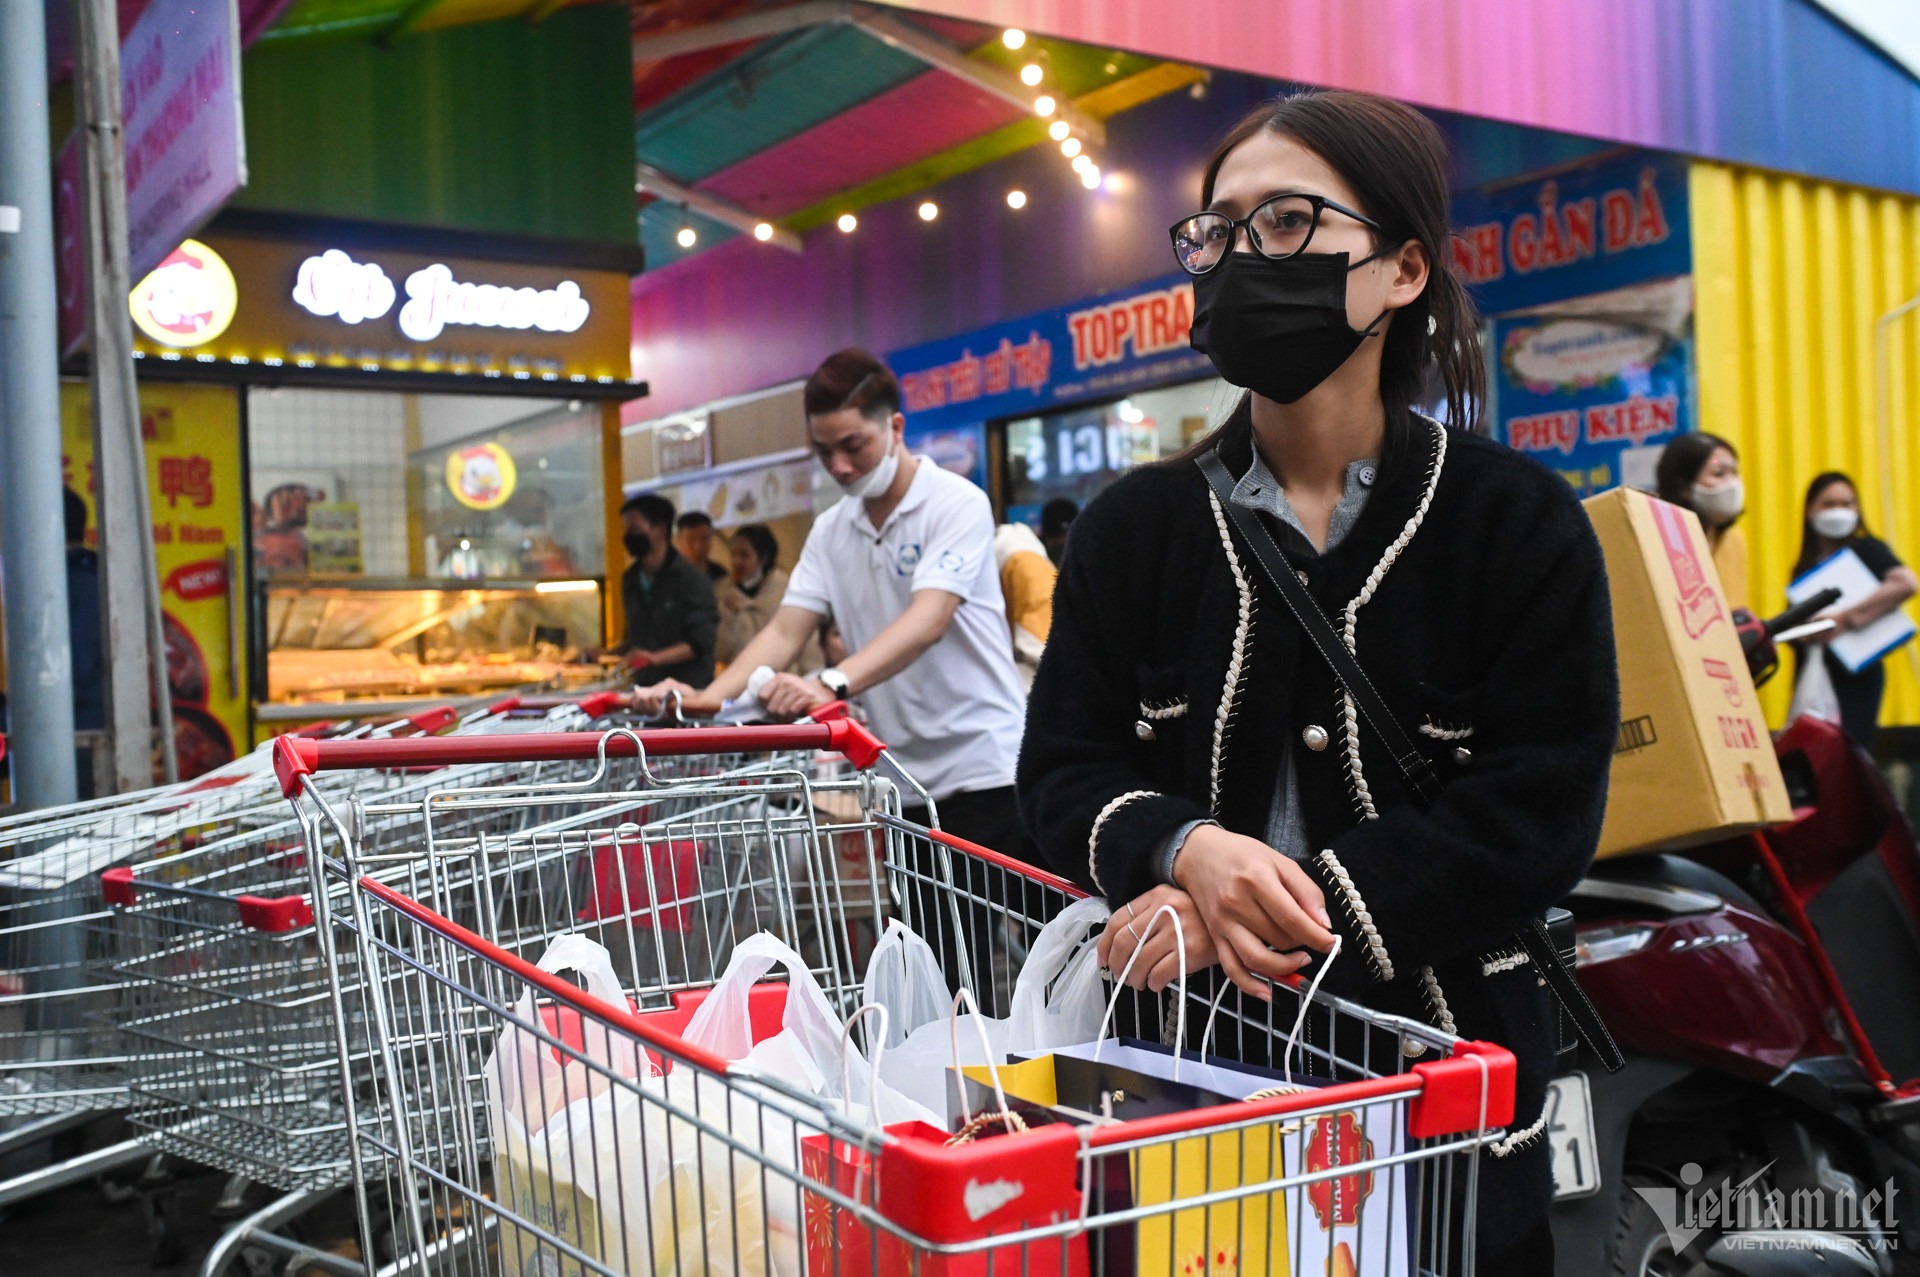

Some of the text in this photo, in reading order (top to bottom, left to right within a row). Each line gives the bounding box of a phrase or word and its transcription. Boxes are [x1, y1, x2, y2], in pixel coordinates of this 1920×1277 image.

[1507, 394, 1679, 456] PHỤ KIỆN
[1325, 1120, 1344, 1222] MAJSTIC
